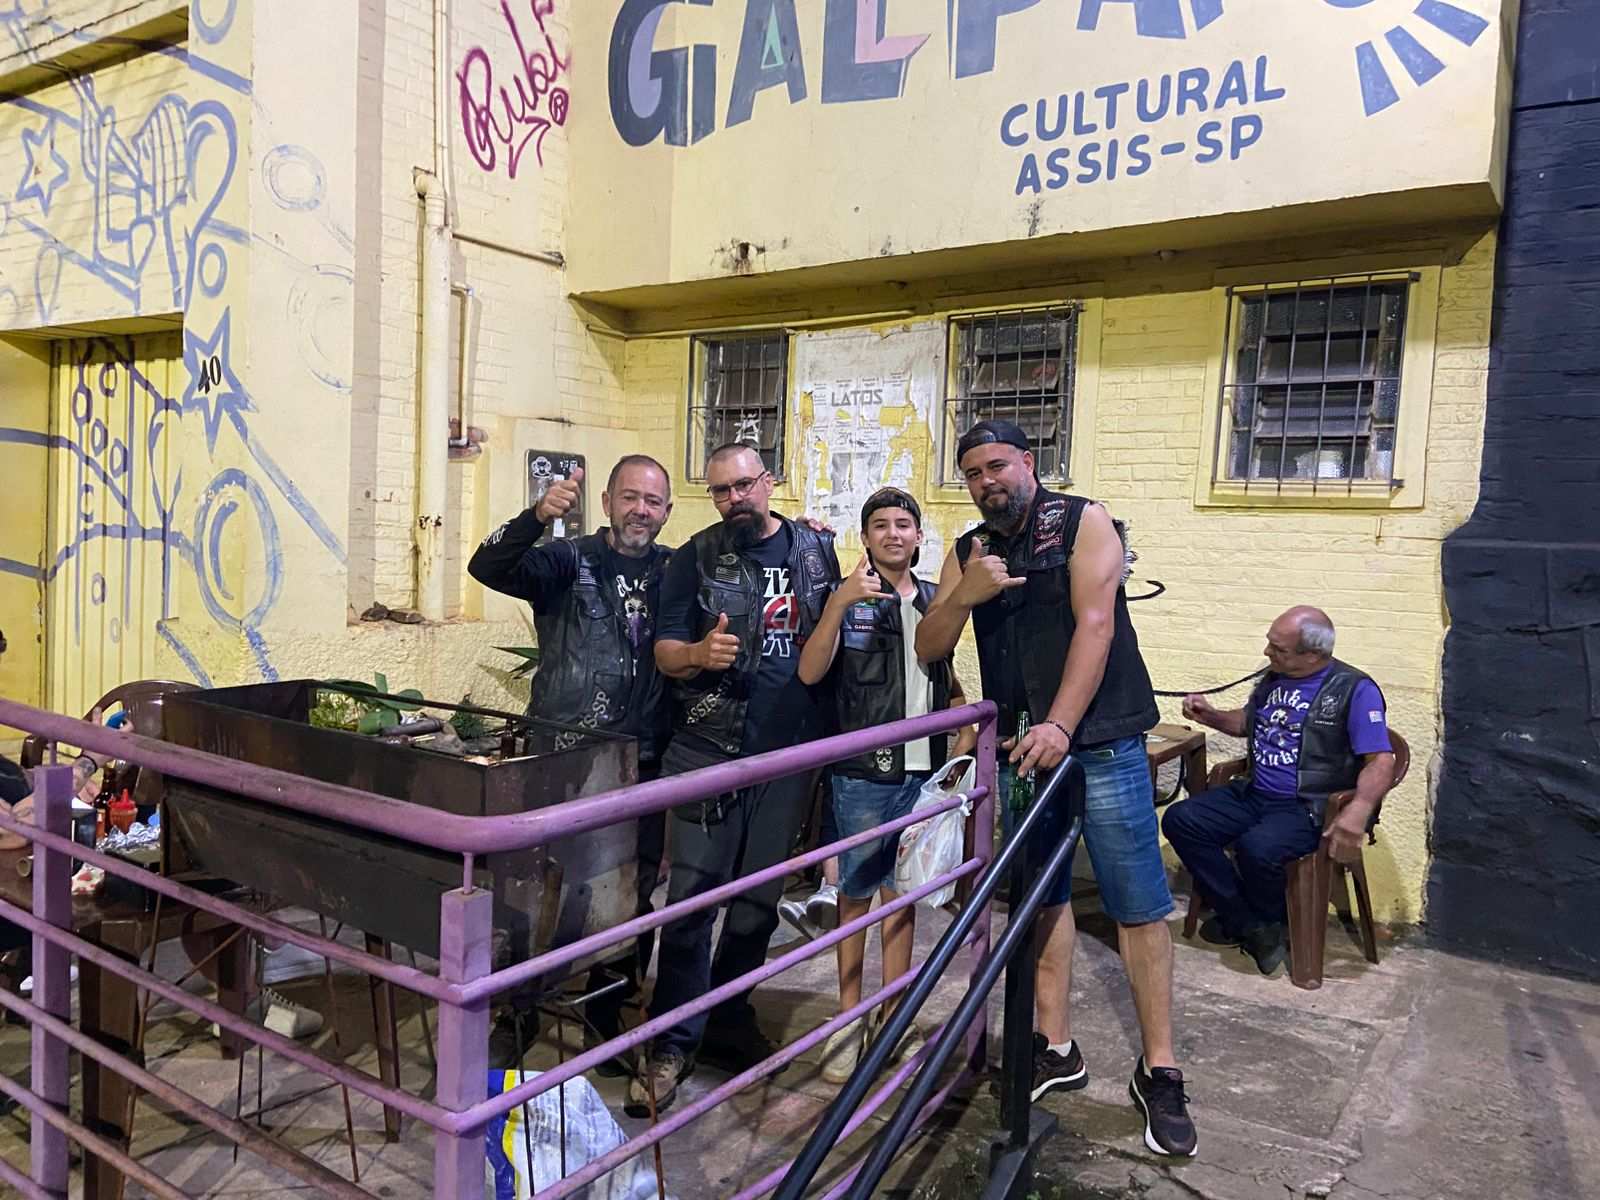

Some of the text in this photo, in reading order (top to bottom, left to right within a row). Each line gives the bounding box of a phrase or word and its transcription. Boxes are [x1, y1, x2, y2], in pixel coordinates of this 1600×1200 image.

[1000, 55, 1286, 147] CULTURAL
[1015, 114, 1263, 195] ASSIS-SP
[198, 355, 222, 394] 40
